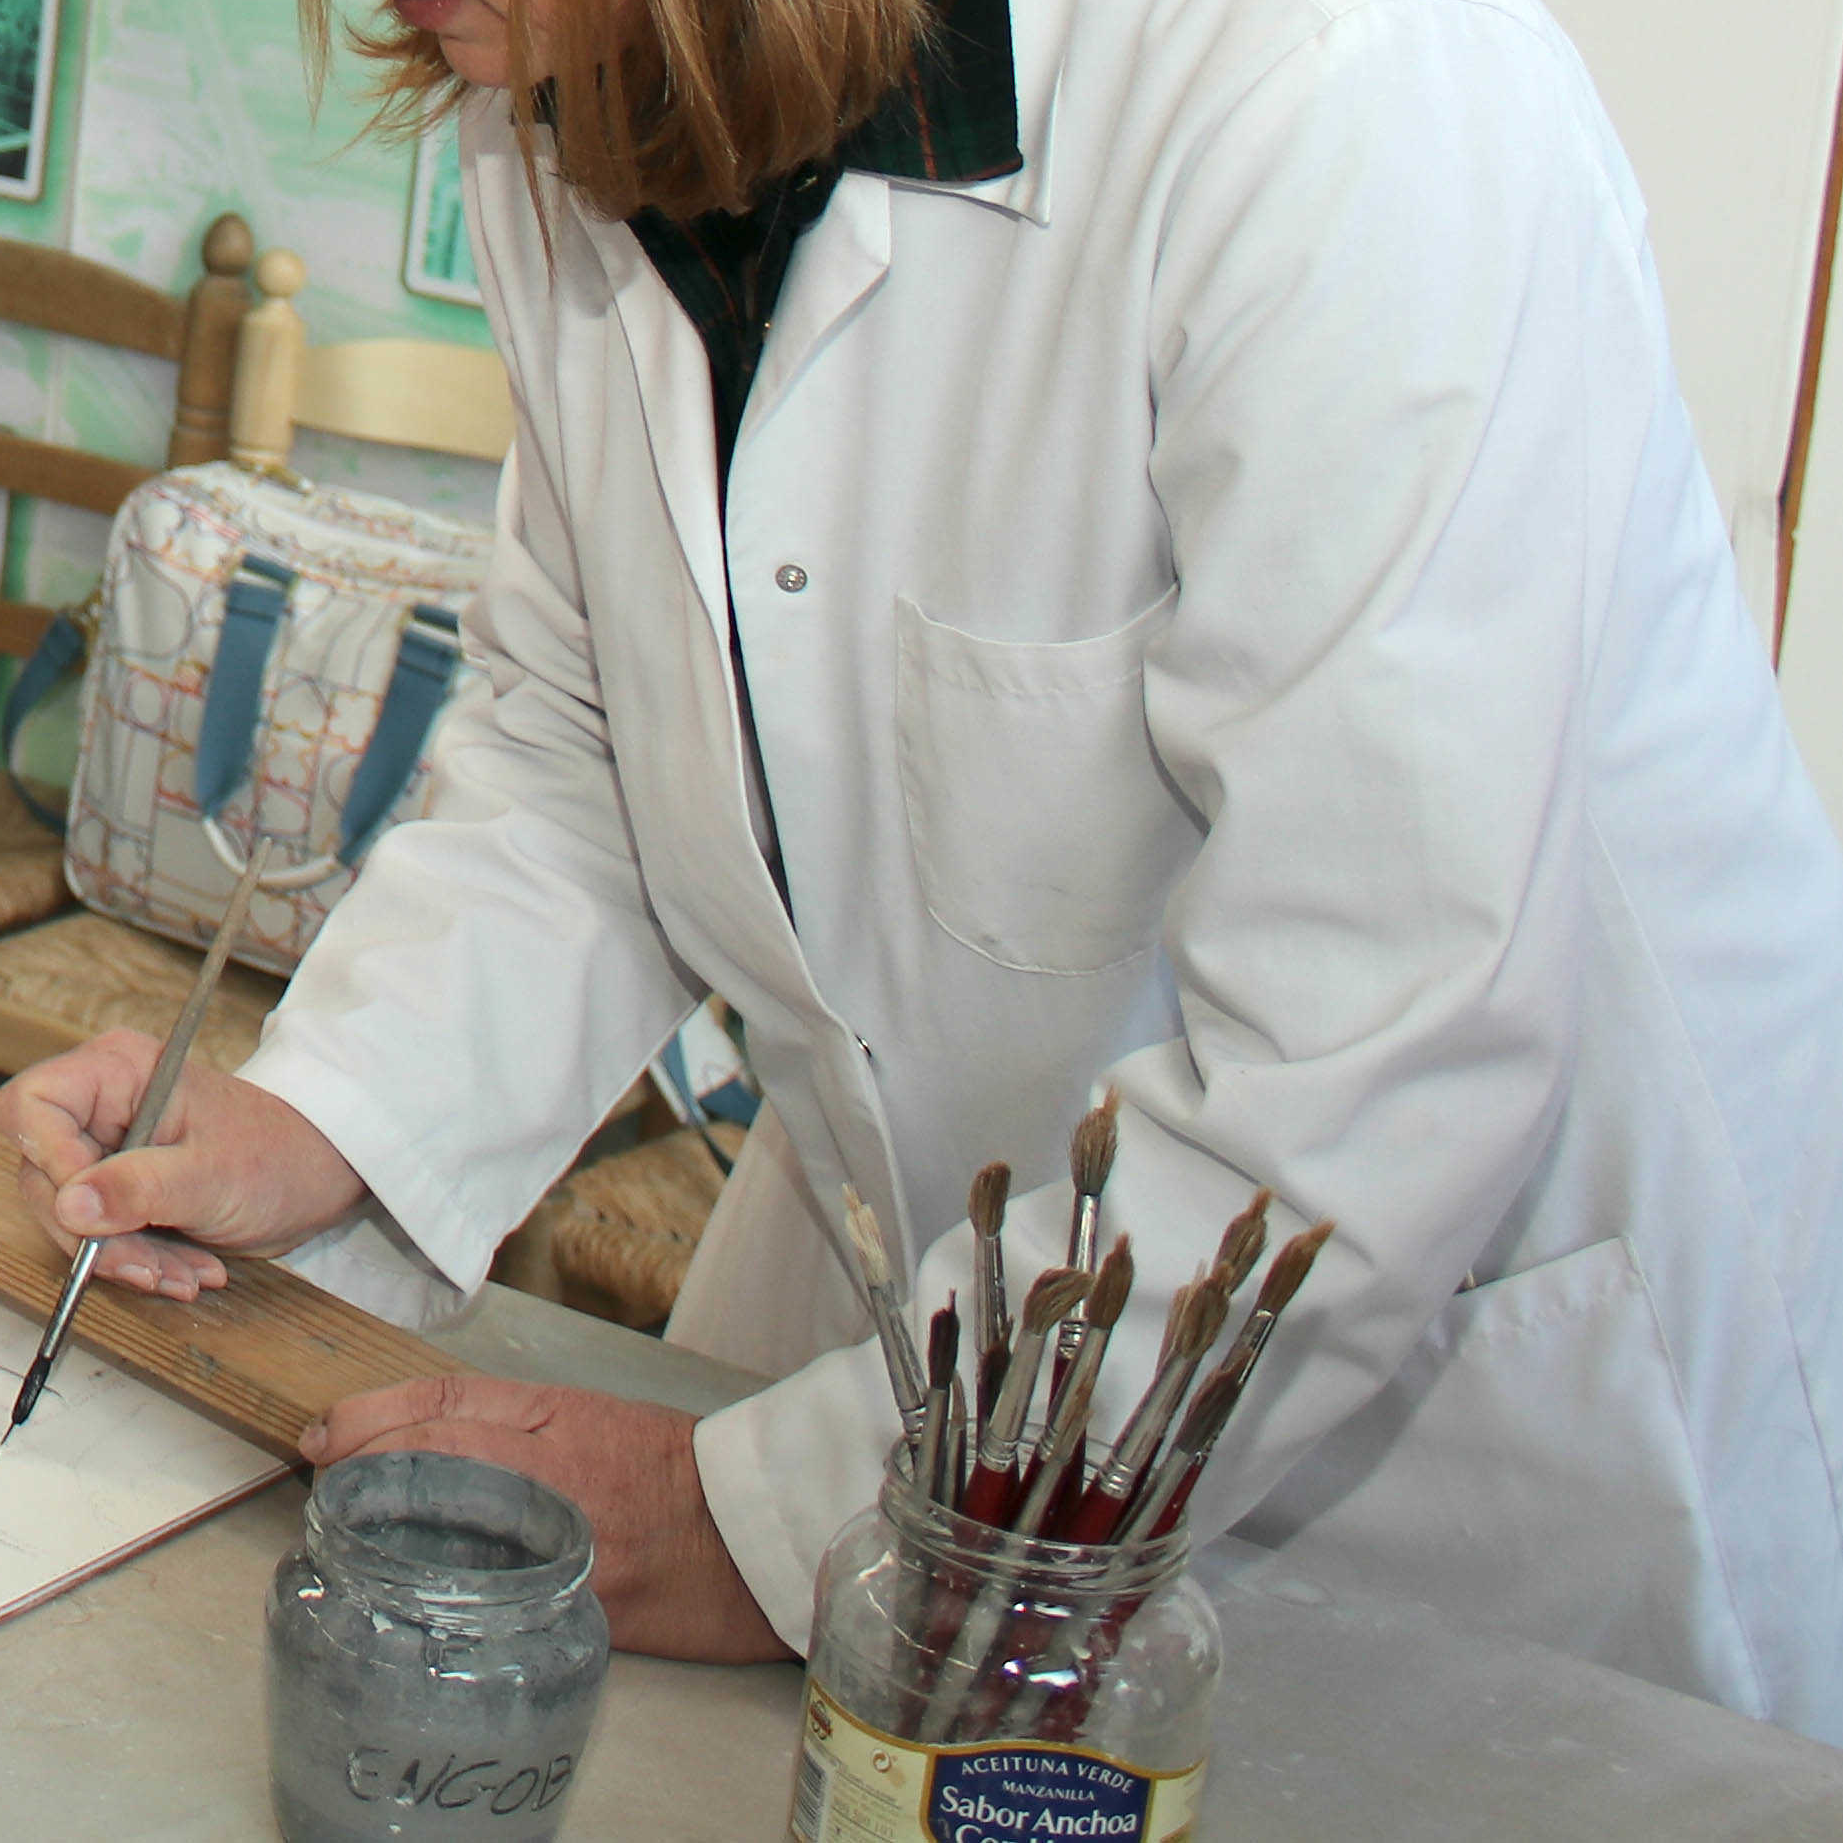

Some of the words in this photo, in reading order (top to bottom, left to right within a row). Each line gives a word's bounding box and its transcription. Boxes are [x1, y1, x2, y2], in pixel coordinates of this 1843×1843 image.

[961, 1756, 1069, 1776] ACEITUNA
[1077, 1763, 1134, 1794] VERDE
[1001, 1779, 1095, 1802] MANZANILLA
[939, 1785, 1030, 1831] Sabor
[1031, 1807, 1138, 1836] Anchoa
